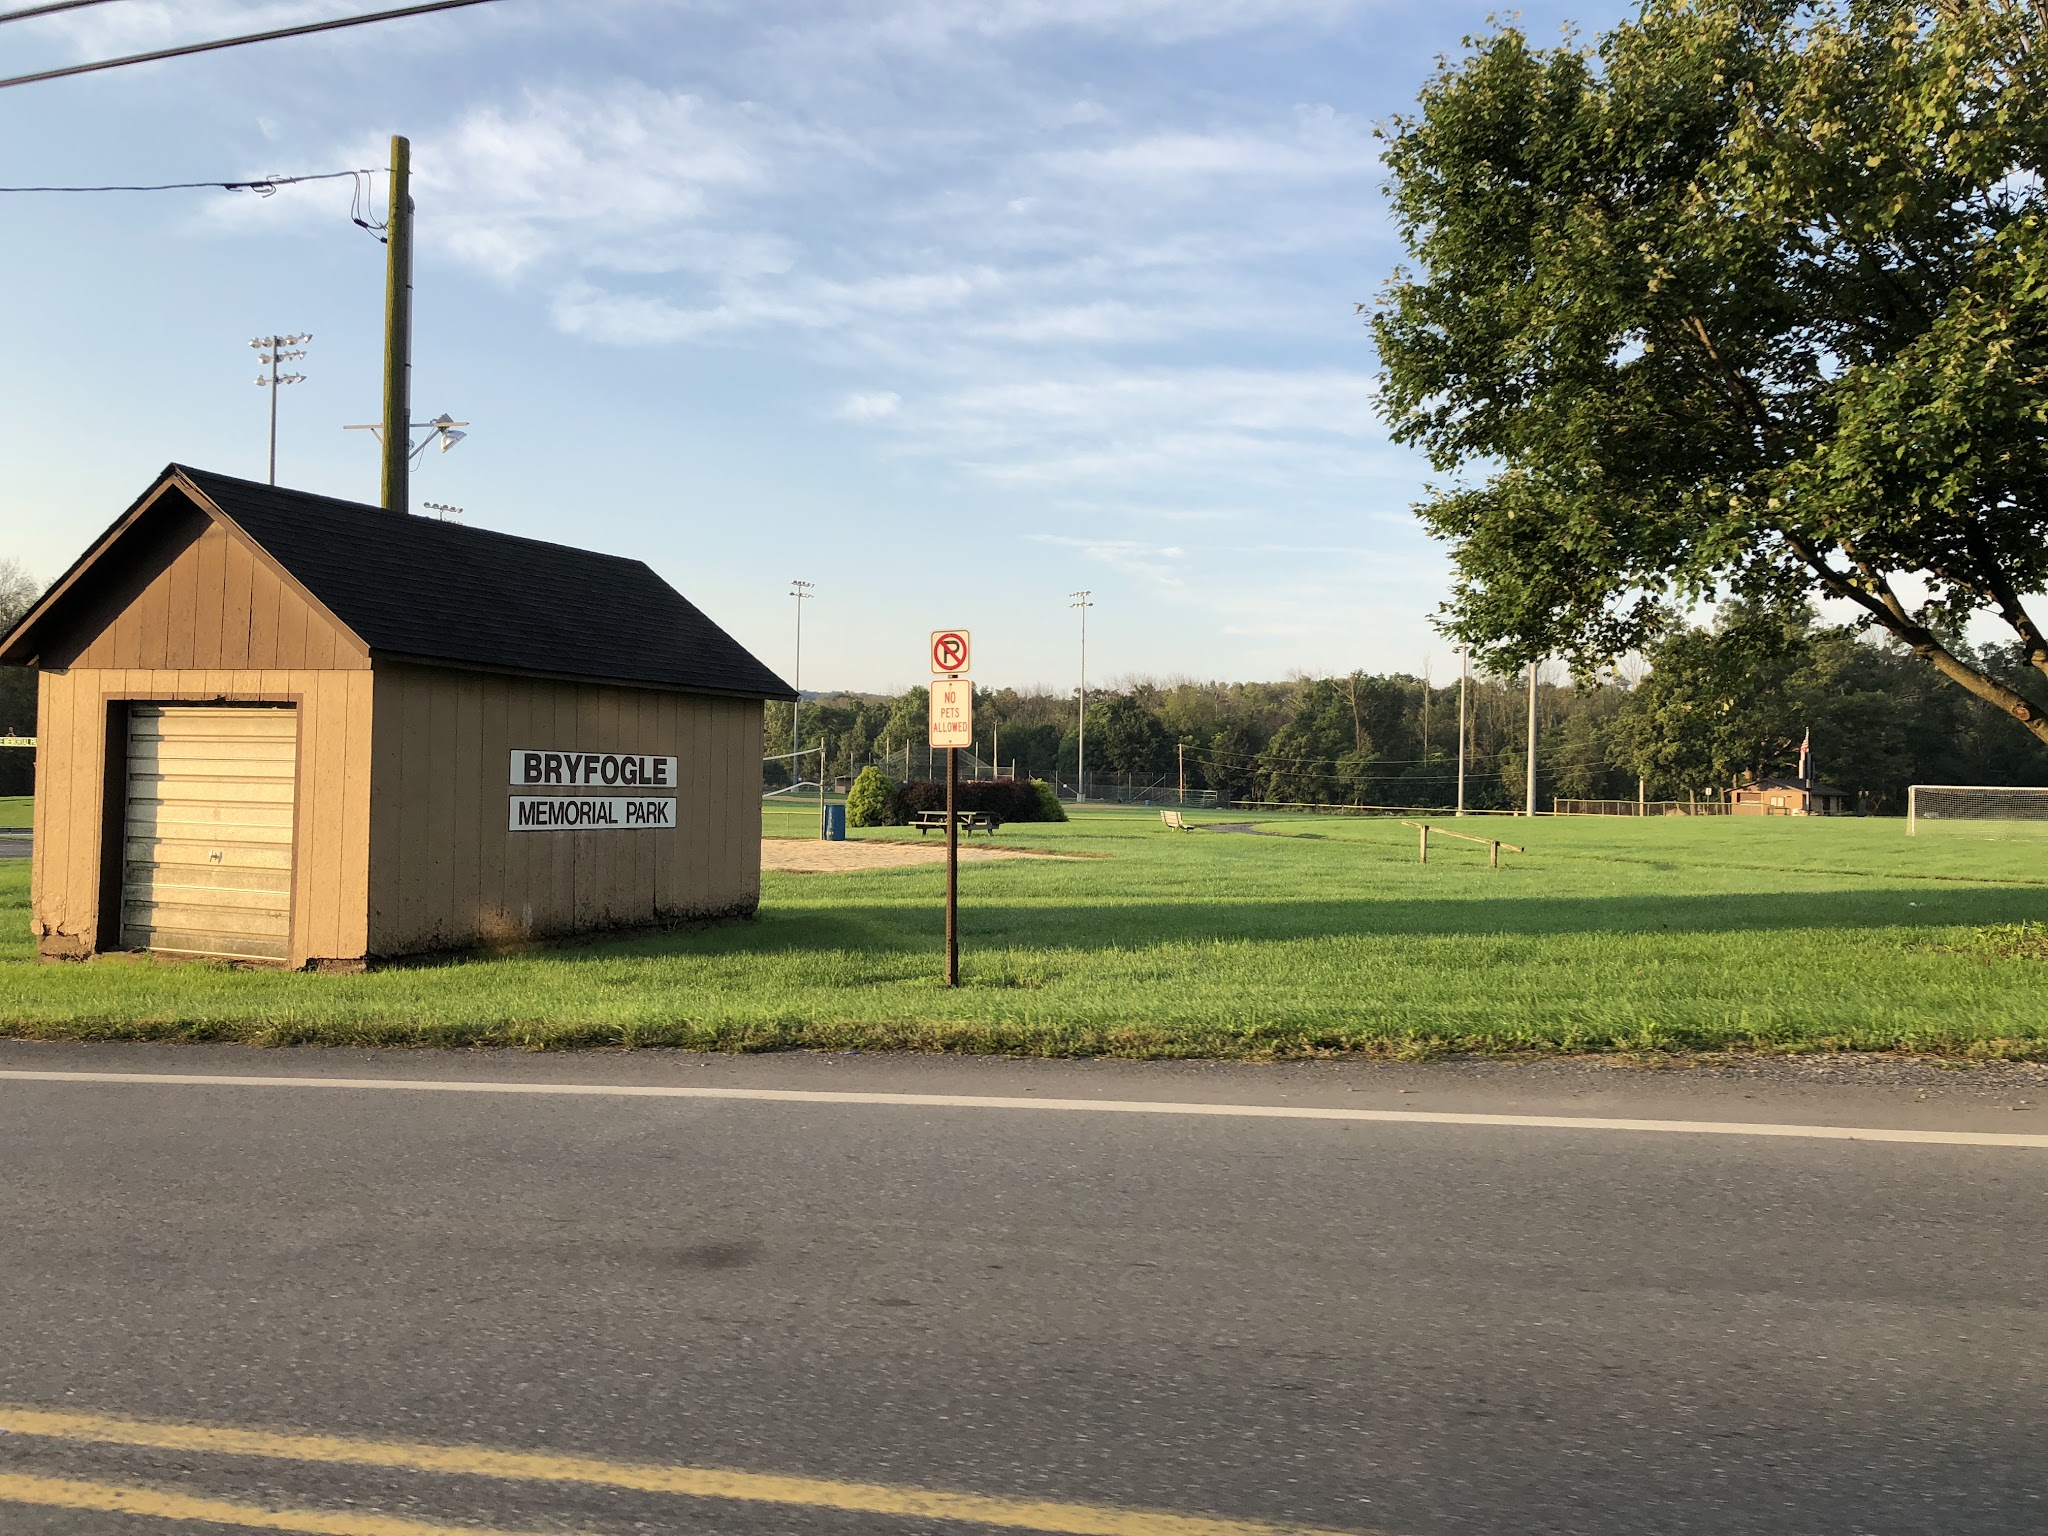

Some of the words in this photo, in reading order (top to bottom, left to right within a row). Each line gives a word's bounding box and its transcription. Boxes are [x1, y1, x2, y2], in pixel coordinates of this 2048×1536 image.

[944, 691, 956, 704] NO
[940, 707, 960, 719] PETS
[933, 721, 968, 733] ALLOWED
[523, 752, 668, 785] BRYFOGLE
[518, 800, 618, 826] MEMORIAL
[626, 801, 669, 824] PARK
